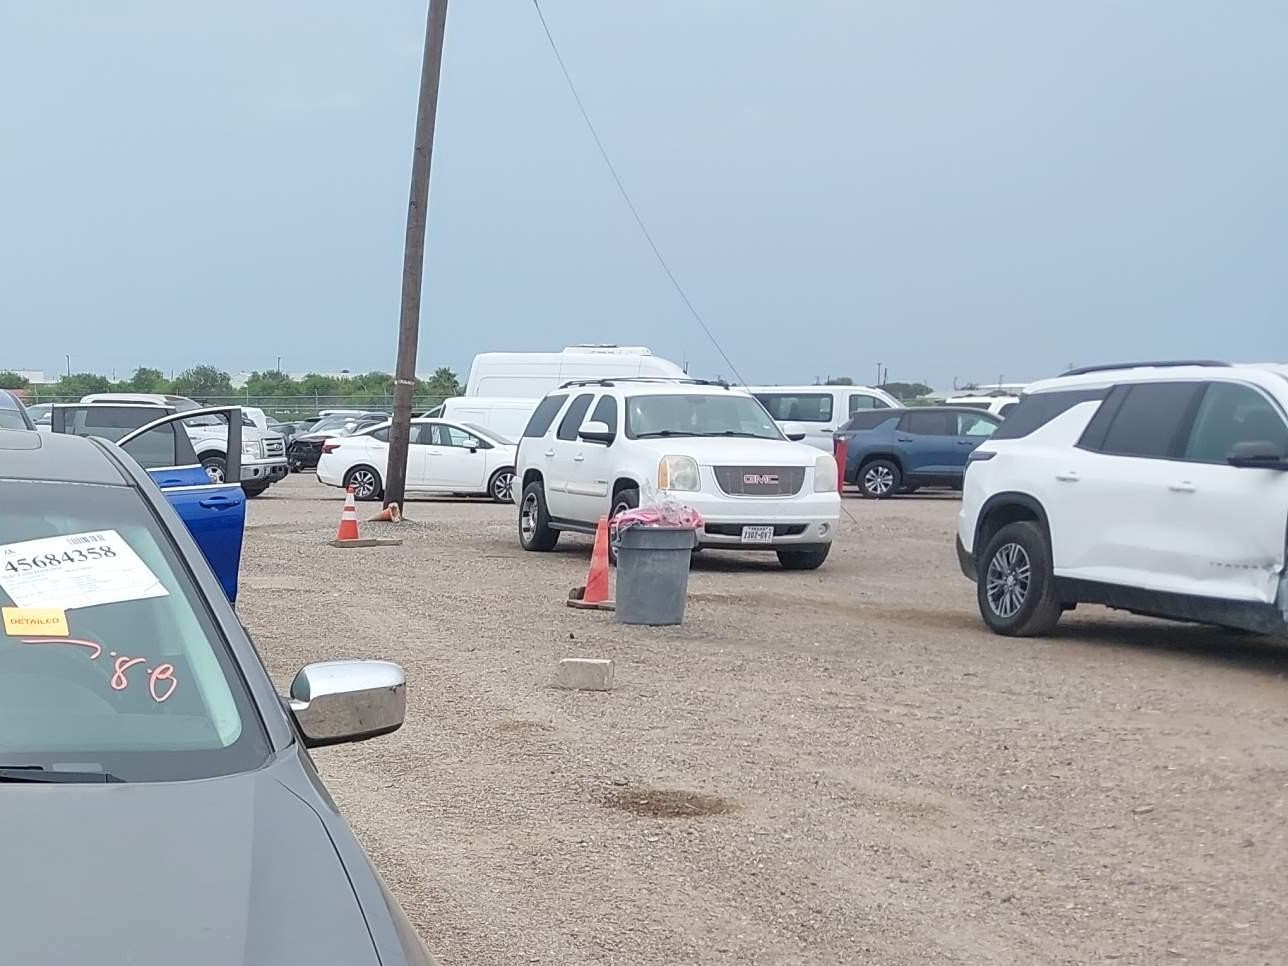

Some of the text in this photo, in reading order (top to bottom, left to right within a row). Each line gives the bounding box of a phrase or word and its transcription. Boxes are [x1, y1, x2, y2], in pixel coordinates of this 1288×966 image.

[743, 474, 779, 484] GMC
[4, 545, 118, 573] 45684358
[10, 617, 60, 626] DETAILED
